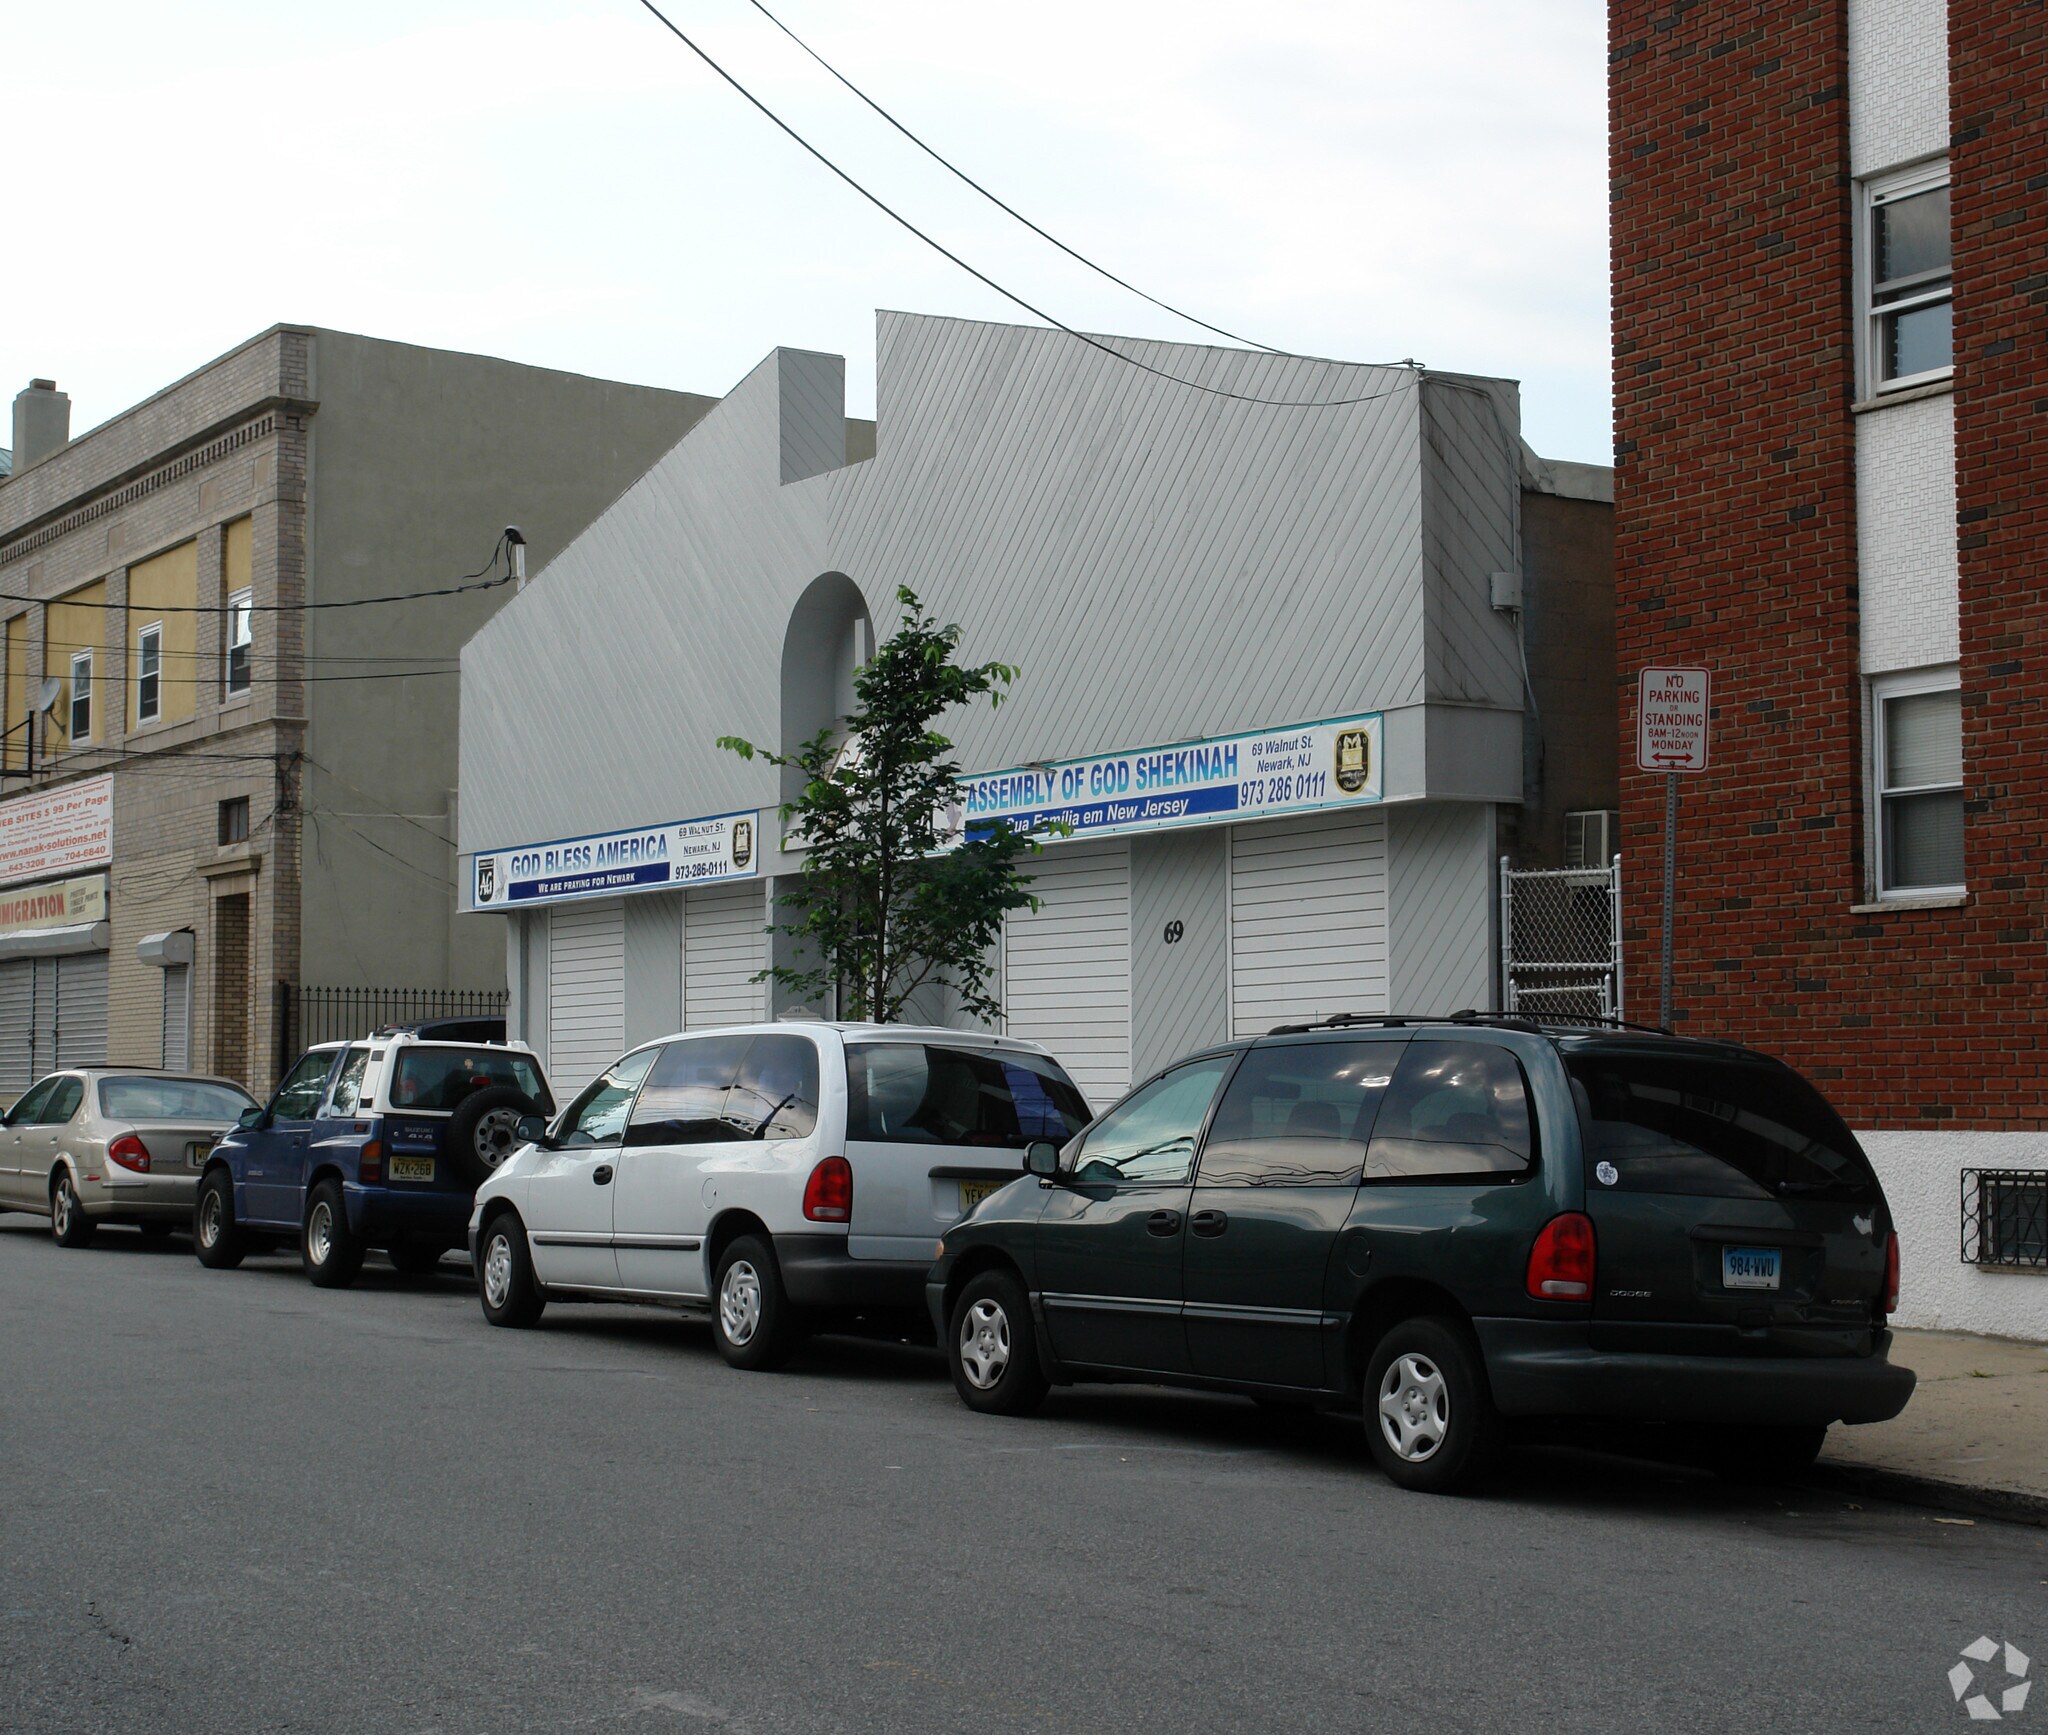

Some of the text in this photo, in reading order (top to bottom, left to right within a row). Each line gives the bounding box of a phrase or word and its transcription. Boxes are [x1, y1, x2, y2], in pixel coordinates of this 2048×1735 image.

[1666, 675, 1684, 688] NO
[1649, 690, 1700, 703] PARKING
[1645, 713, 1703, 726] STANDING
[1251, 736, 1314, 756] 69 Walnut St.
[1651, 740, 1693, 750] MONDAY
[1257, 753, 1312, 773] Newark, NJ
[966, 743, 1238, 813] ASSEMBLY OF GOD SHEKINAH
[1241, 770, 1326, 806] 973 286 0111
[16, 810, 42, 824] SITES
[45, 808, 50, 816] $
[53, 804, 64, 814] 99
[66, 801, 82, 811] Per
[85, 794, 109, 806] Page
[1083, 811, 1103, 824] em
[1107, 804, 1138, 820] New
[1140, 799, 1189, 818] Jersey
[678, 827, 687, 837] 69
[511, 834, 668, 878] GOD BLESS AMERICA
[712, 841, 721, 851] NJ
[675, 860, 727, 880] 973-286-0111
[0, 893, 65, 925] MIGRATION
[1164, 920, 1184, 944] 69
